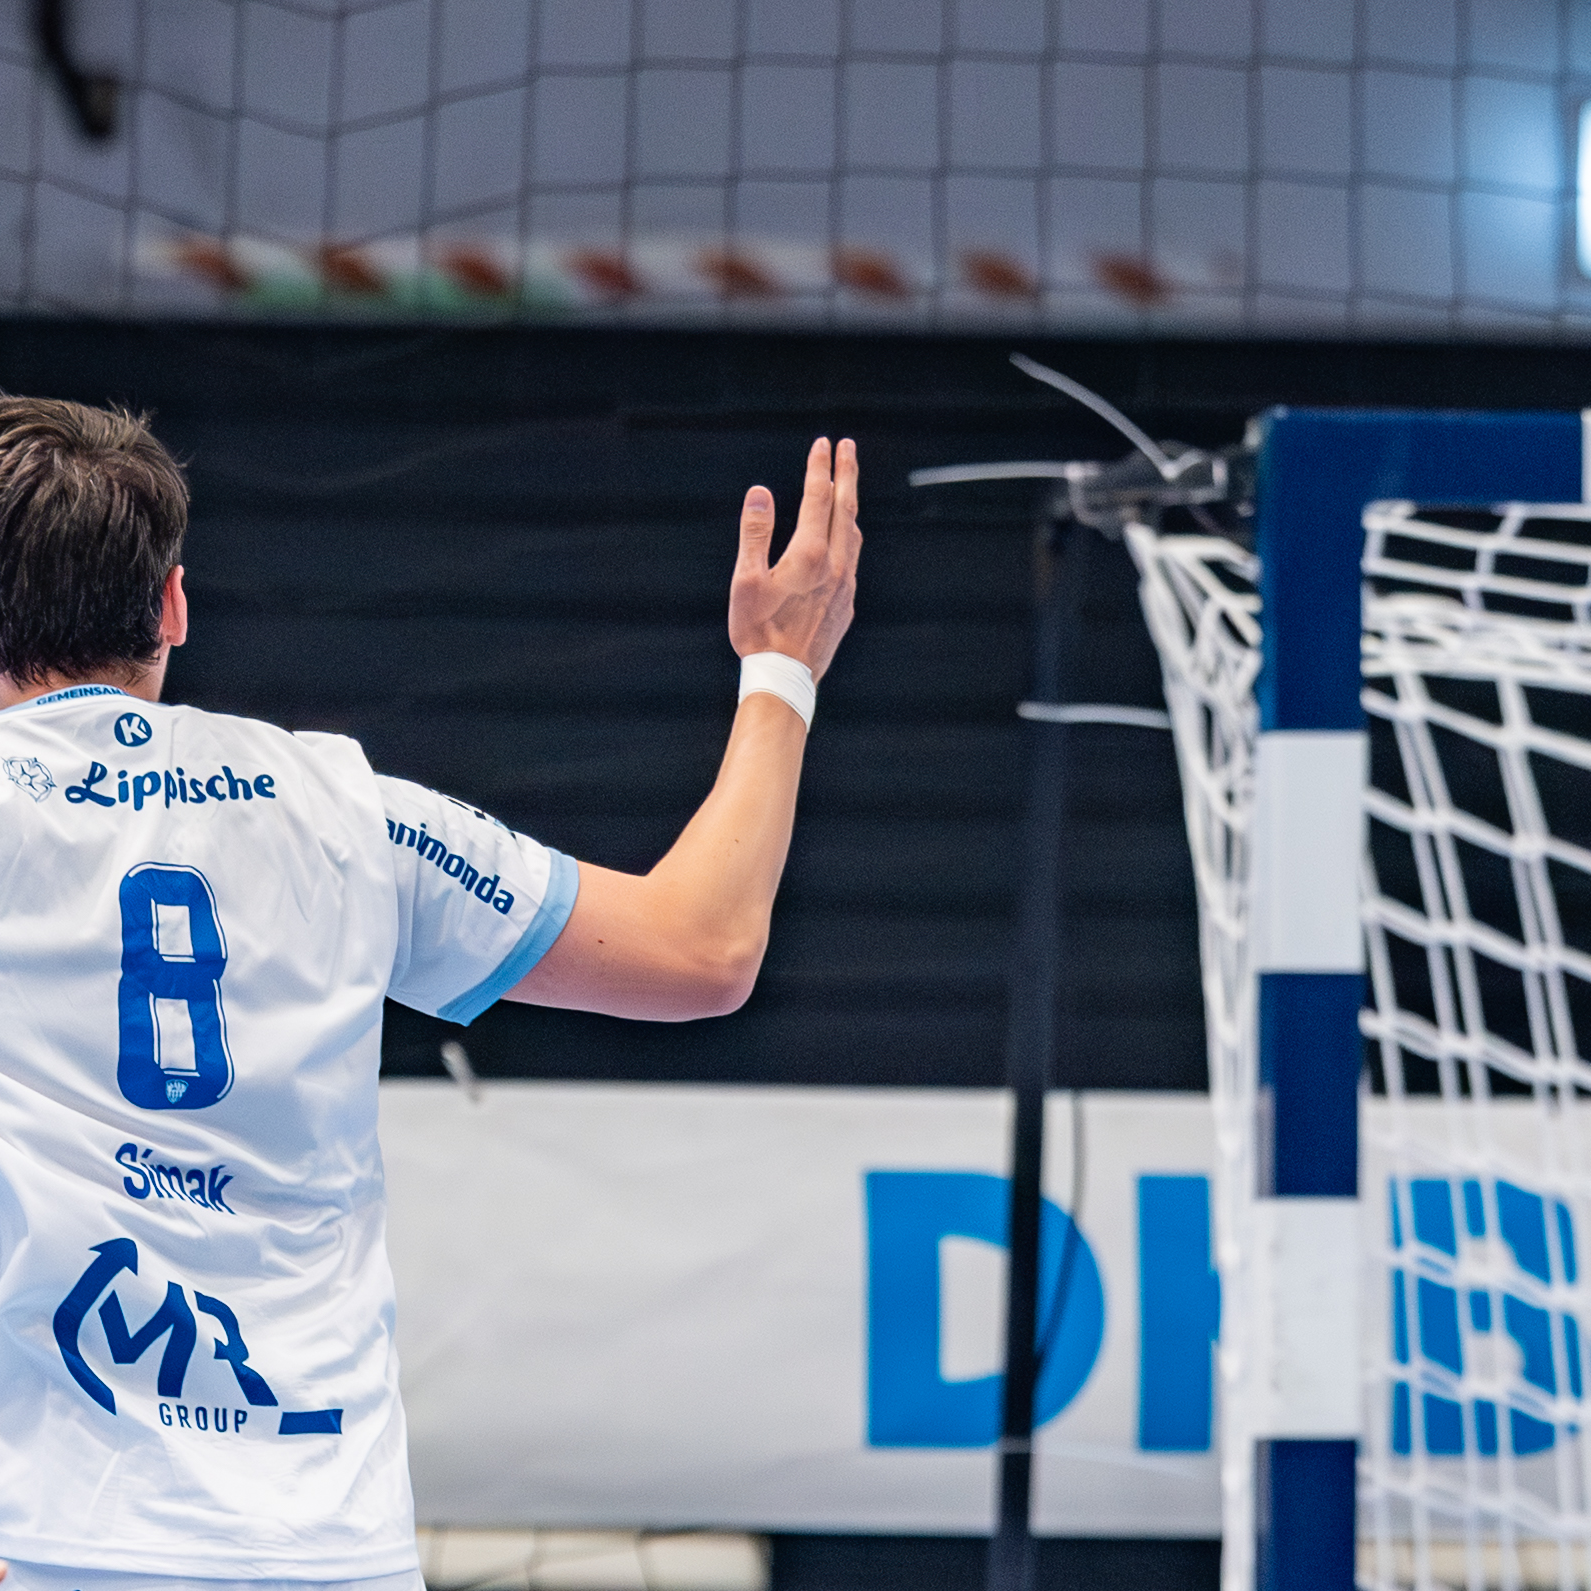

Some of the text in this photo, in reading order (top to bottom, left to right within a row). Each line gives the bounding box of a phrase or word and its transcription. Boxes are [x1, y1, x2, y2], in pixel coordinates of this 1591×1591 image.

[64, 760, 276, 811] Lippische
[117, 861, 235, 1110] 8
[115, 1142, 236, 1215] Simak
[158, 1402, 248, 1433] GROUP
